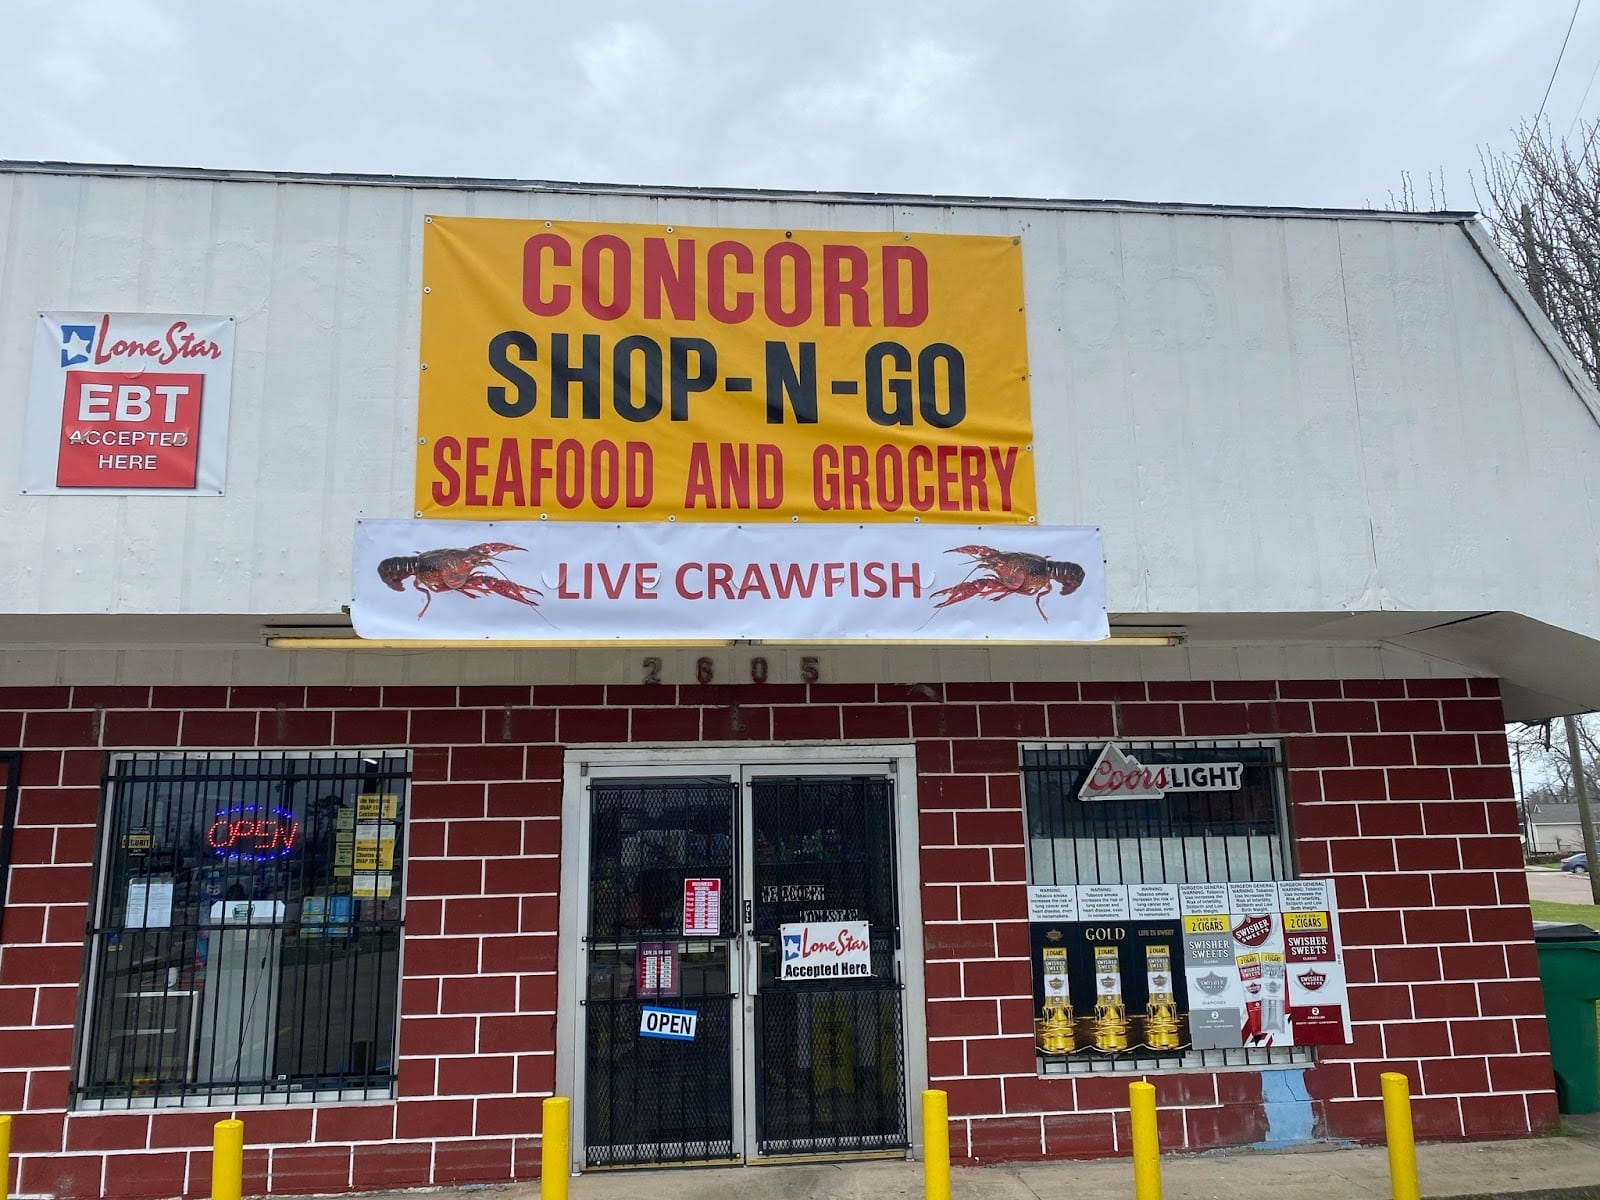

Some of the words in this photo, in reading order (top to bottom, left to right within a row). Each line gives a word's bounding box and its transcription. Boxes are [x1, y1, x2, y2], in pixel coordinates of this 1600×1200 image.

[522, 233, 929, 328] CONCORD
[487, 330, 966, 428] SHOP-N-GO
[78, 383, 190, 423] EBT
[69, 430, 188, 447] ACCEPTED
[98, 454, 157, 470] HERE
[431, 436, 654, 509] SEAFOOD
[684, 442, 784, 509] AND
[812, 443, 1019, 512] GROCERY
[558, 562, 658, 600] LIVE
[675, 562, 921, 600] CRAWFISH
[1088, 760, 1169, 790] Coors
[1171, 766, 1239, 788] LIGHT
[208, 820, 298, 848] OPEN
[1192, 922, 1196, 931] 2
[1198, 921, 1224, 931] CIGARS
[1236, 918, 1270, 938] SWISHER
[1291, 919, 1295, 928] 2
[1297, 918, 1322, 927] CIGARS
[1085, 928, 1126, 940] GOLD
[1242, 927, 1269, 943] SWEETS
[1288, 936, 1328, 946] SWISHER
[1189, 940, 1230, 950] SWISHER
[1292, 946, 1327, 955] SWEETS
[1192, 950, 1229, 959] SWEETS
[785, 963, 838, 977] Accepted
[647, 1013, 692, 1034] OPEN
